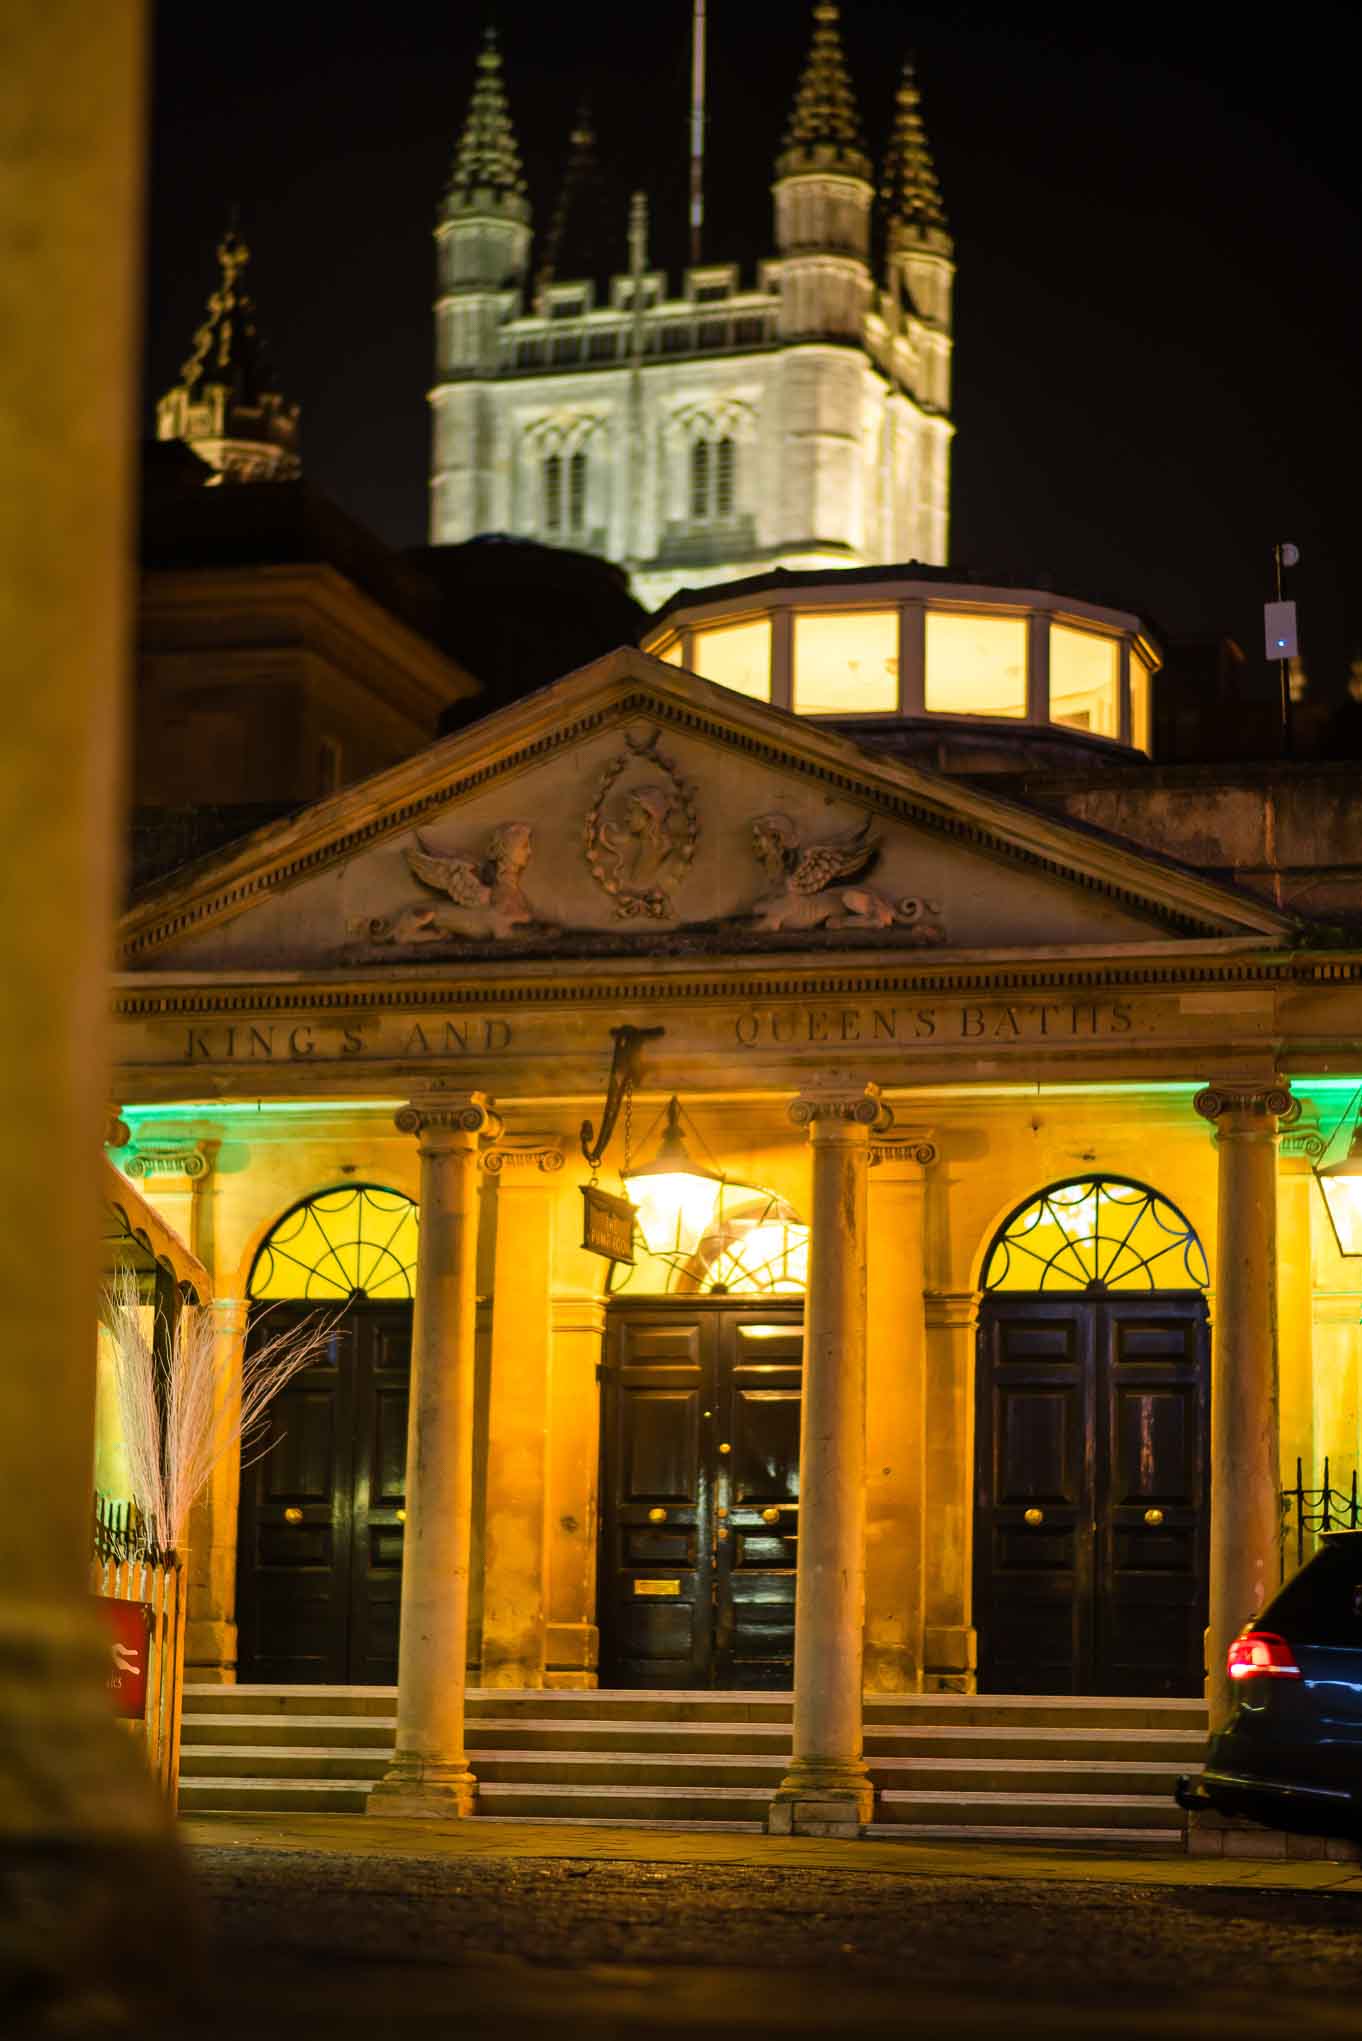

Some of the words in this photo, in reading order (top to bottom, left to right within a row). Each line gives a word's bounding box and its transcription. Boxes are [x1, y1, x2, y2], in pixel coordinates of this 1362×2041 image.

[187, 1024, 365, 1059] KINGS
[405, 1018, 510, 1055] AND
[736, 1007, 938, 1048] QUEENS
